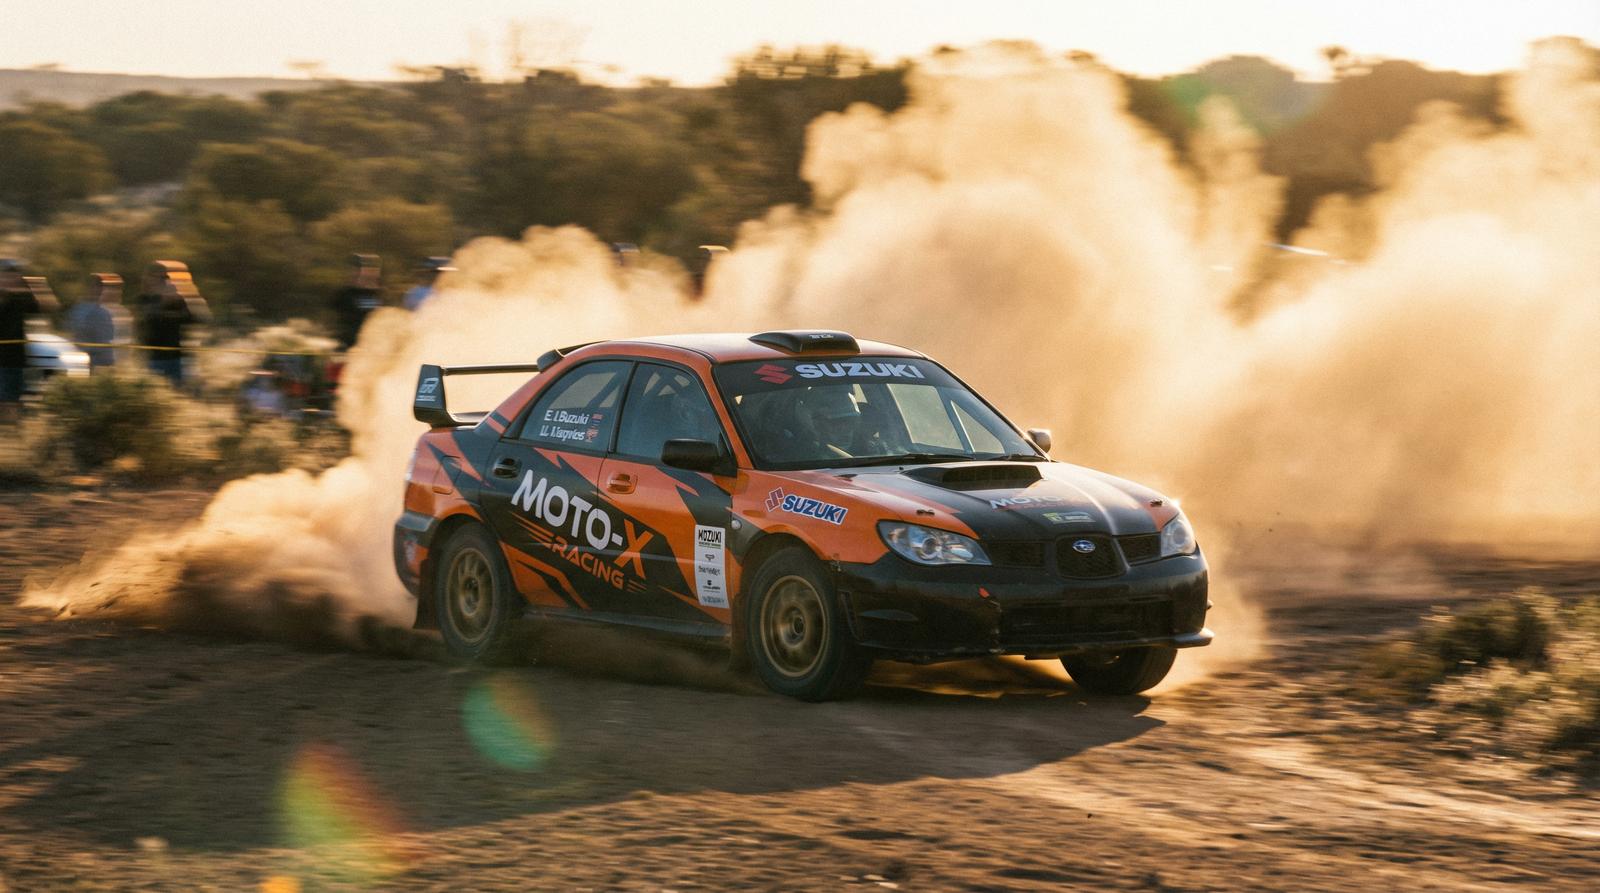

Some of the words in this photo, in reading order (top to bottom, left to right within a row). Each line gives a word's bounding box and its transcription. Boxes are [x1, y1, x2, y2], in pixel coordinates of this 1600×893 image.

[795, 362, 925, 379] SUZUKI
[510, 469, 654, 580] MOTO-X
[781, 494, 848, 525] SUZUKI
[551, 535, 625, 590] RACING
